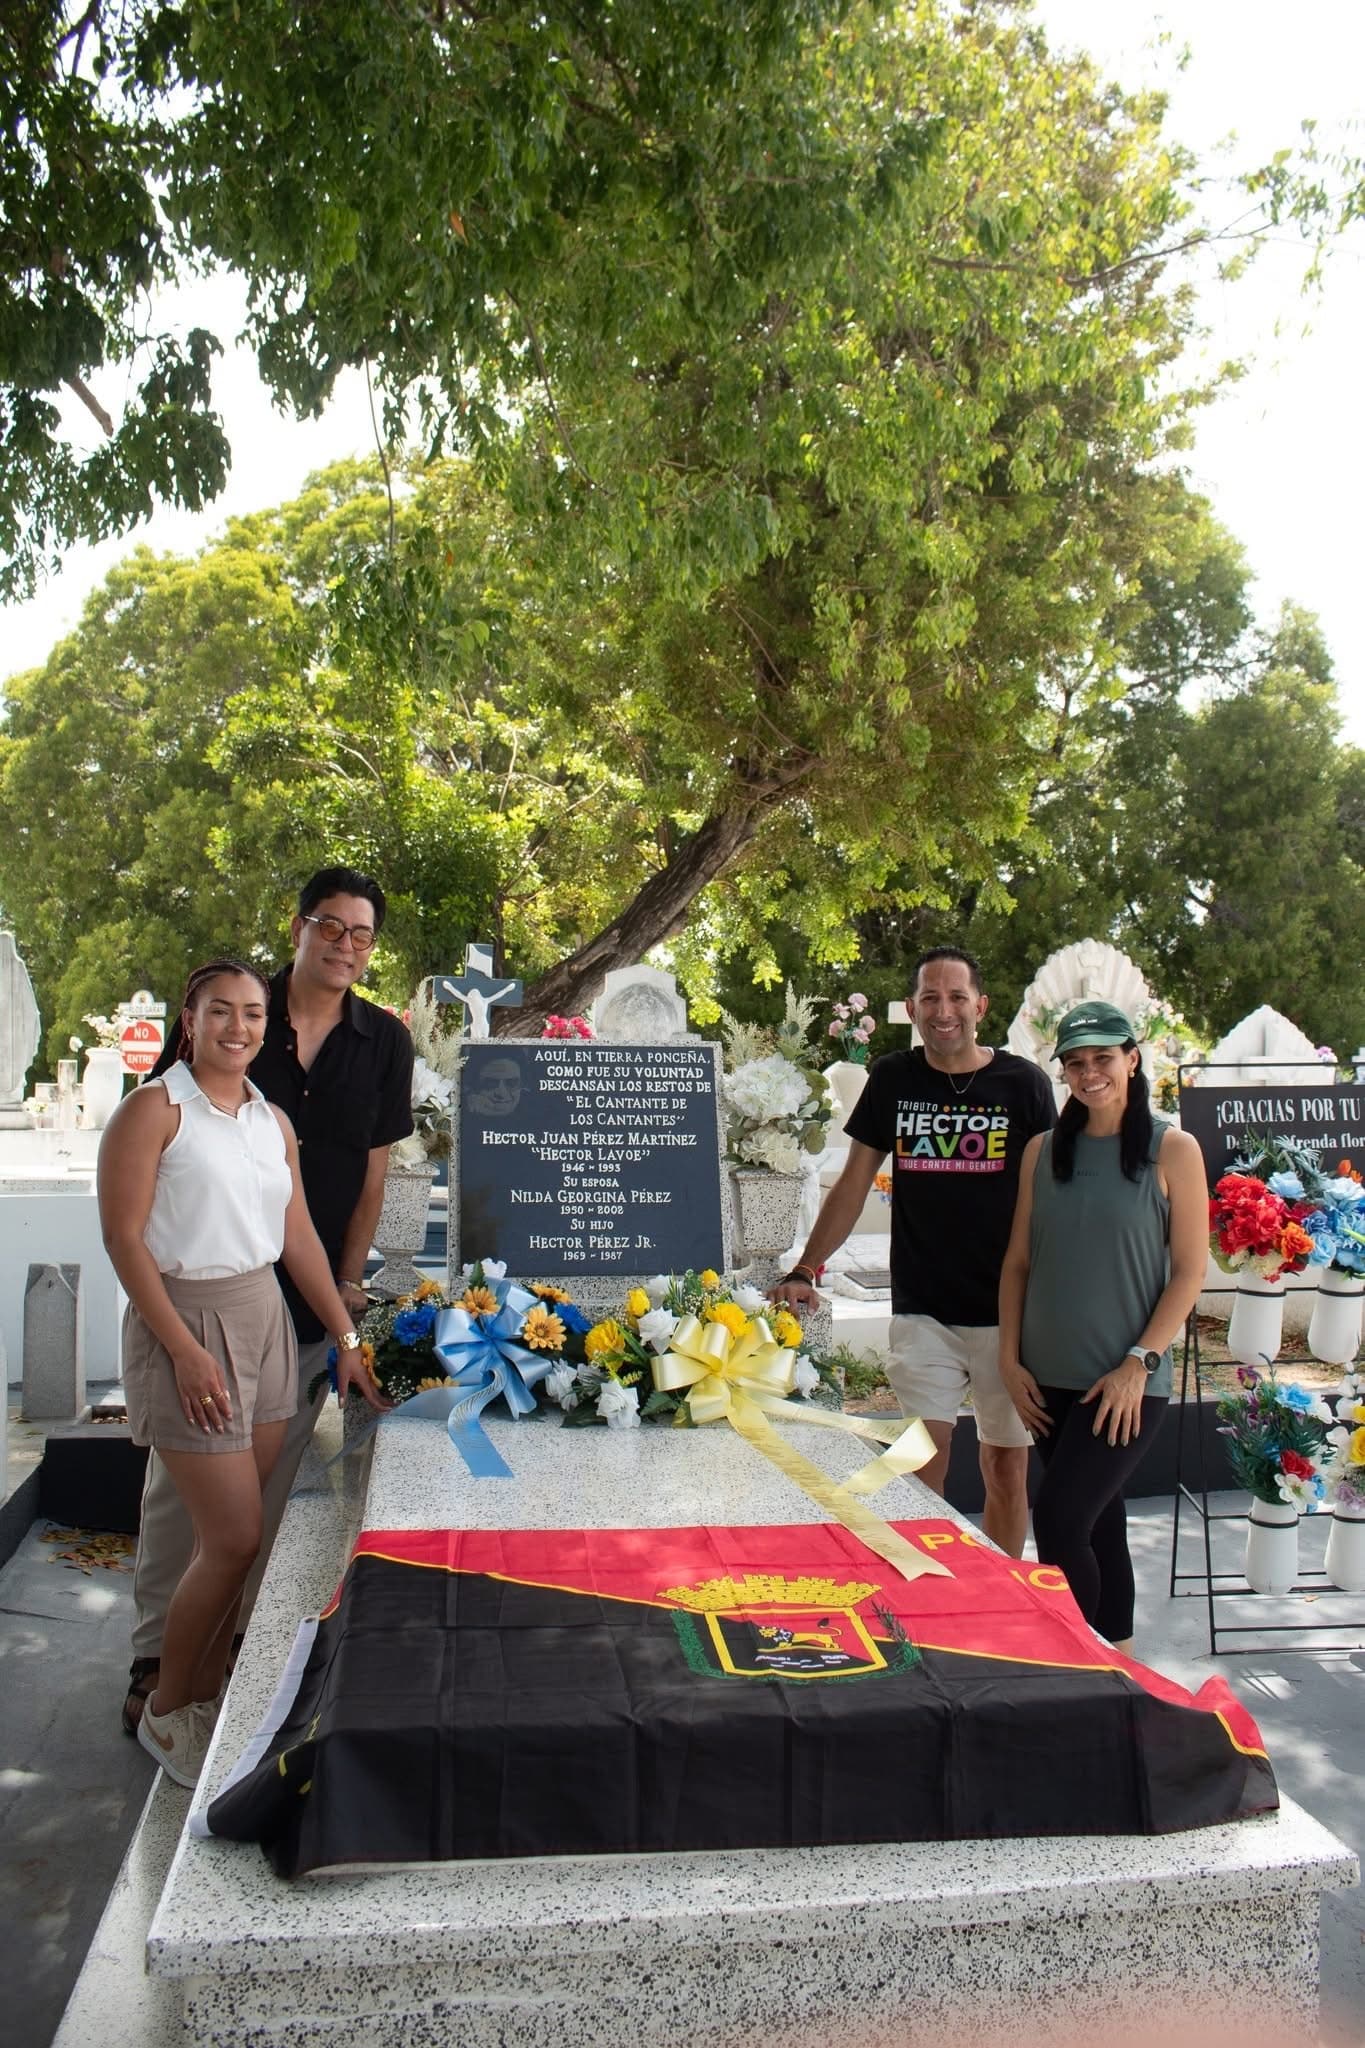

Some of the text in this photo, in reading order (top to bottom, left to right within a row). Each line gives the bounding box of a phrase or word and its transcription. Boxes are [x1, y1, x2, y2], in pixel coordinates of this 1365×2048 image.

[133, 1027, 149, 1039] NO
[127, 1054, 155, 1065] ENTRE
[575, 1051, 592, 1062] EN
[596, 1051, 643, 1063] TIERRA
[547, 1066, 704, 1079] COMO FUE SU VOLUNTAD
[539, 1080, 711, 1093] DESCANSAN LOS RESTOS DE
[596, 1096, 668, 1109] CANTANTE
[672, 1098, 687, 1109] DE
[897, 1100, 939, 1112] TRIBUTO
[570, 1114, 593, 1125] LOS
[1216, 1098, 1361, 1129] ¡GRACIAS POR TU
[896, 1113, 1009, 1137] HECTOR
[482, 1131, 697, 1146] HECTOR JUAN PÉREZ MARTÍNEZ
[1283, 1133, 1337, 1149] frenda
[896, 1131, 1008, 1160] LAVOE
[562, 1163, 585, 1173] 1946
[598, 1163, 621, 1173] 1993
[922, 1160, 952, 1170] CANTE
[956, 1161, 965, 1170] MI
[563, 1176, 619, 1188] SU ESPOSA
[511, 1188, 671, 1203] NILDA GEORGINA PÉREZ
[560, 1205, 584, 1215] 1950
[597, 1205, 624, 1215] 2002
[570, 1219, 613, 1231] SU HIJO
[530, 1234, 656, 1249] HECTOR PÉREZ JR.
[563, 1251, 586, 1261] 1969
[601, 1251, 622, 1261] 1987
